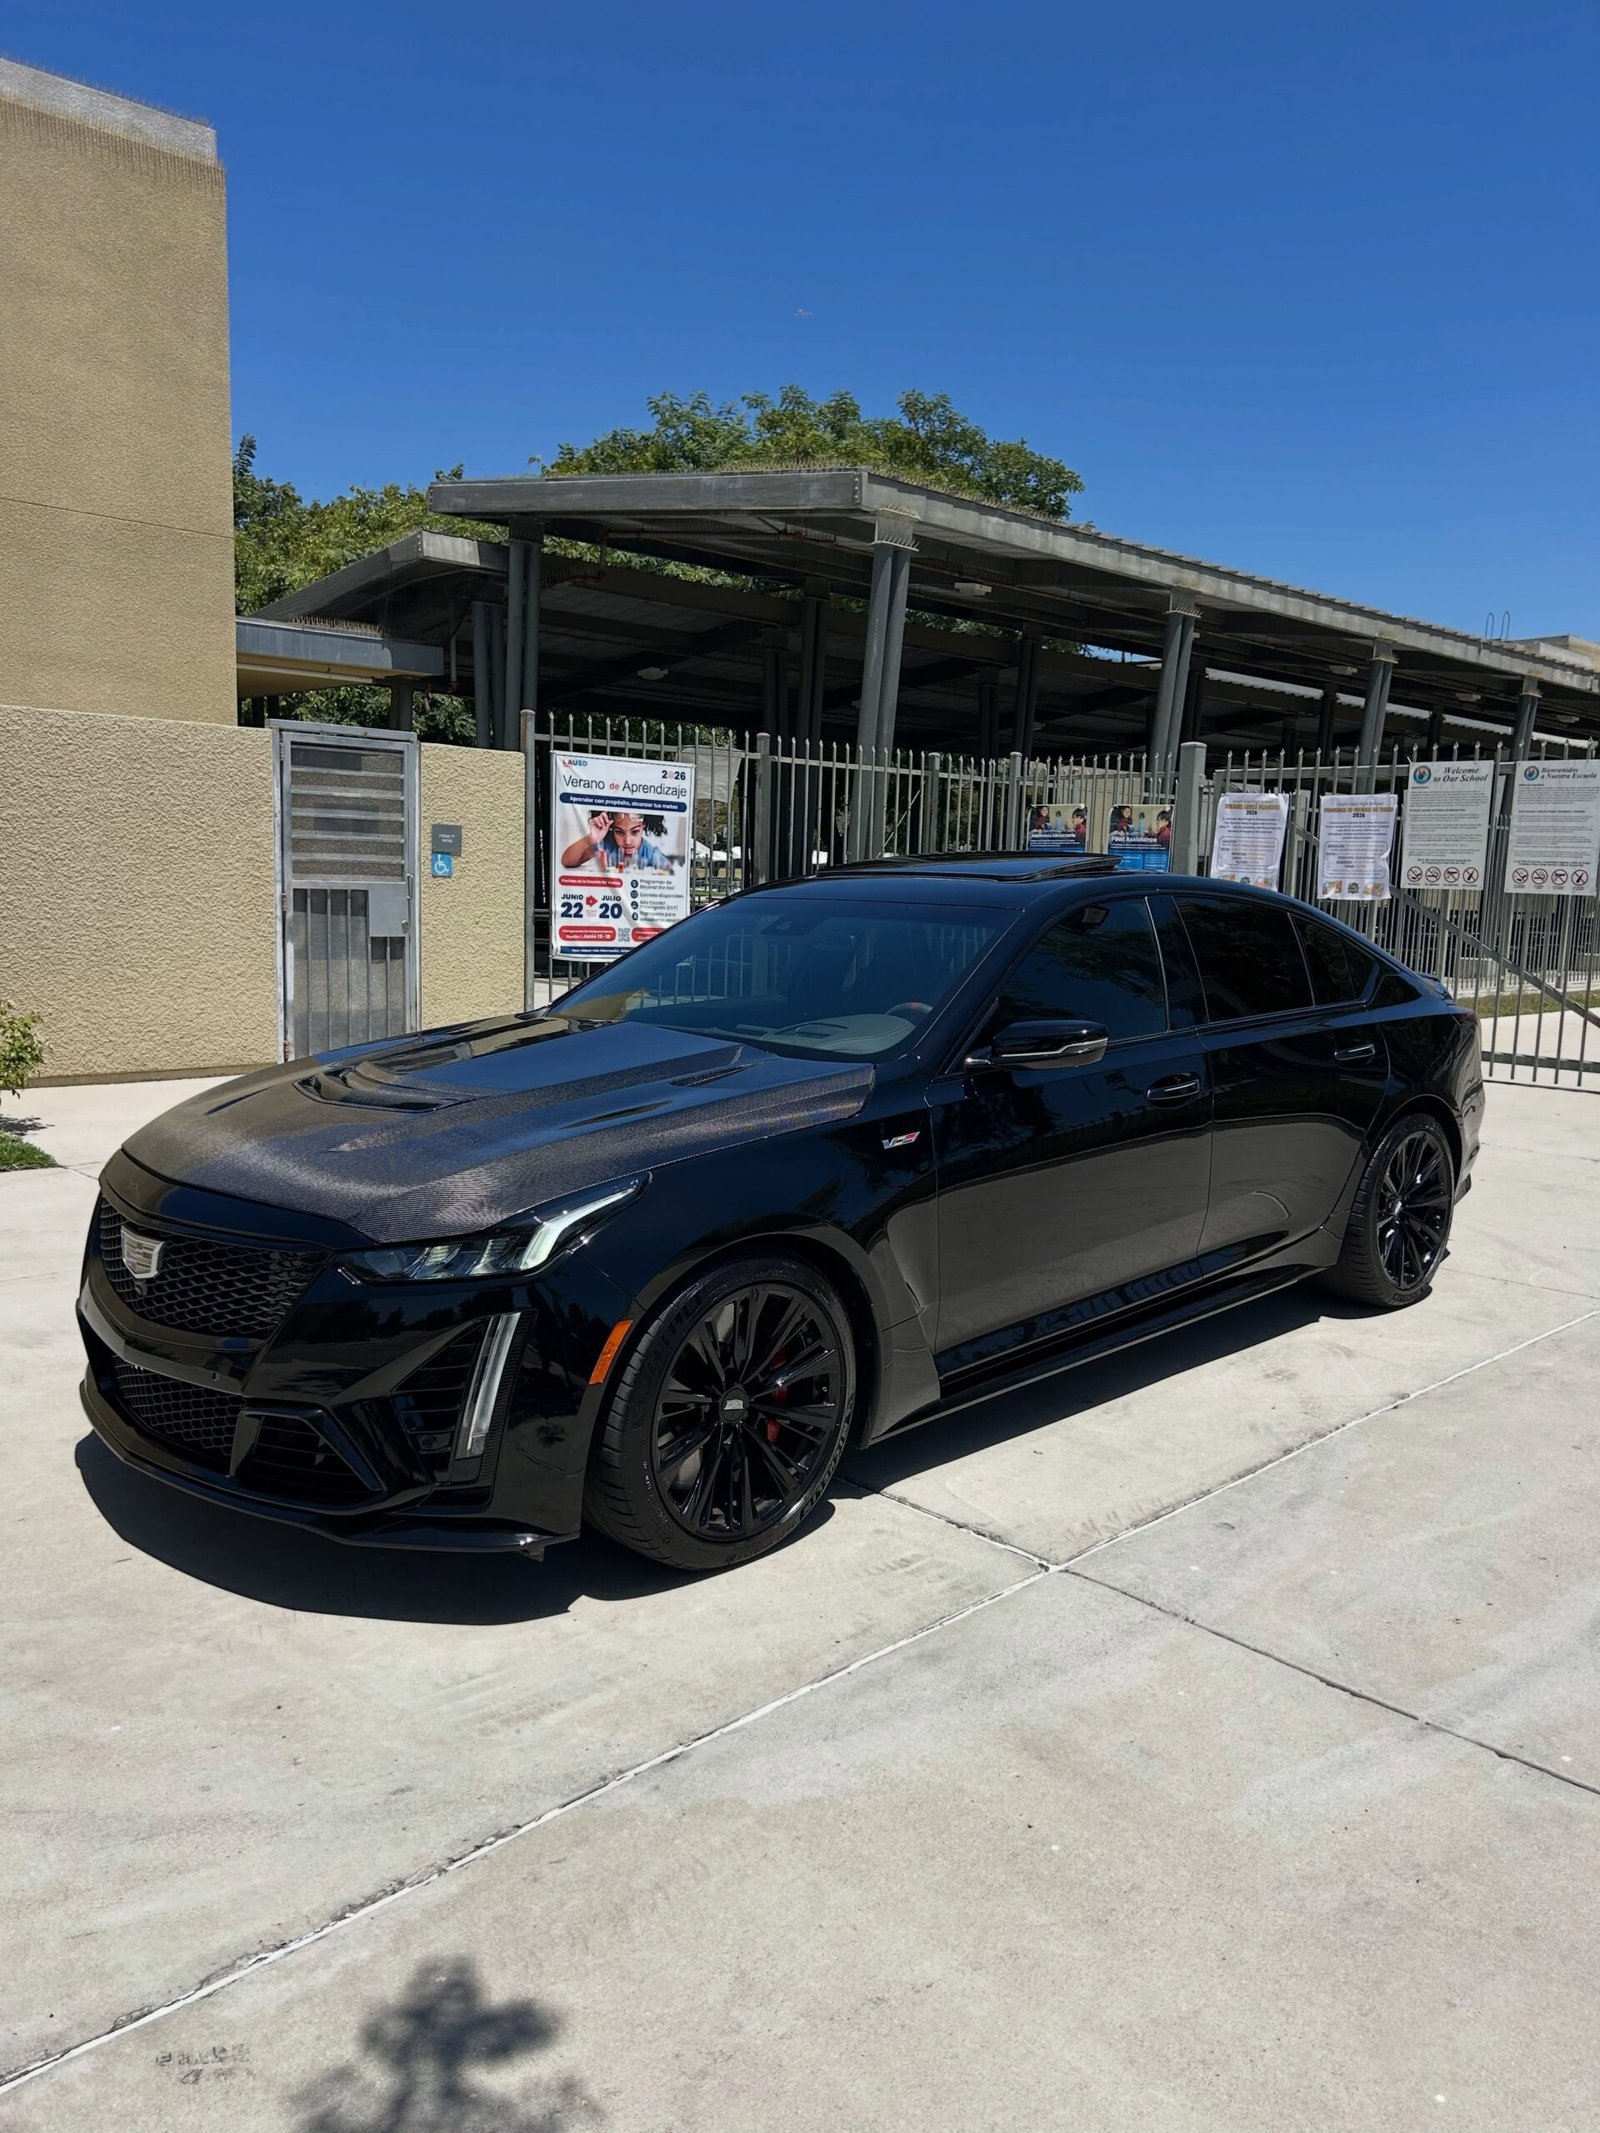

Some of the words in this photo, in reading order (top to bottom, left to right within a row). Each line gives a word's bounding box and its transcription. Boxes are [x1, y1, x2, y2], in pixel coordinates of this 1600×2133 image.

[562, 759, 588, 767] LAUSD
[1444, 766, 1480, 774] Welcome
[1433, 775, 1441, 783] to
[1442, 774, 1460, 783] Our
[1460, 774, 1489, 783] School
[563, 774, 605, 790] Verano
[609, 782, 620, 790] de
[622, 780, 688, 799] Aprendizaje
[569, 795, 594, 804] Aprender
[601, 894, 622, 902] JULIO
[560, 901, 584, 918] 22
[598, 902, 623, 919] 20
